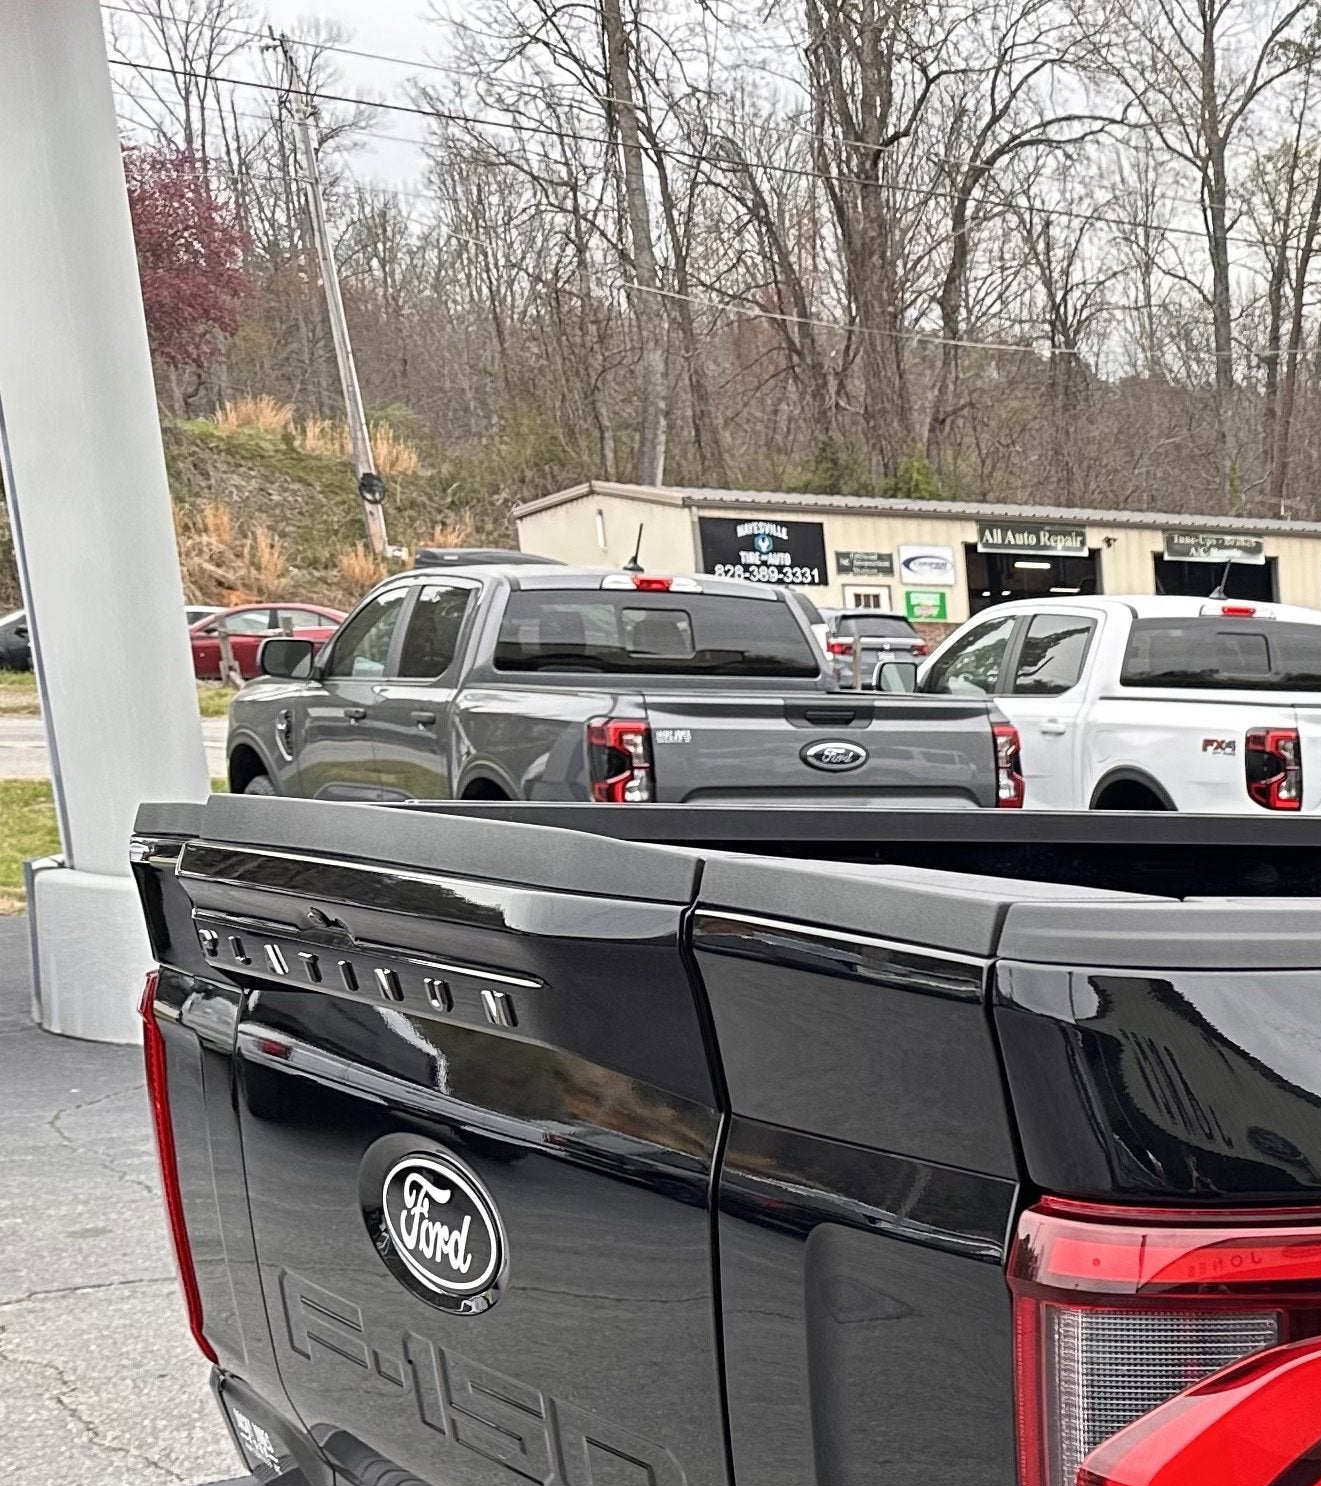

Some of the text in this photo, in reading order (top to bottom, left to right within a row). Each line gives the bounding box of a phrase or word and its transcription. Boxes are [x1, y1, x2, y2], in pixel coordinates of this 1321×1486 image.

[982, 528, 1083, 550] All Auto Repair
[714, 563, 820, 584] 828-389-3331
[822, 746, 854, 763] Ford
[1202, 738, 1236, 752] FX4
[400, 1171, 472, 1274] Ford
